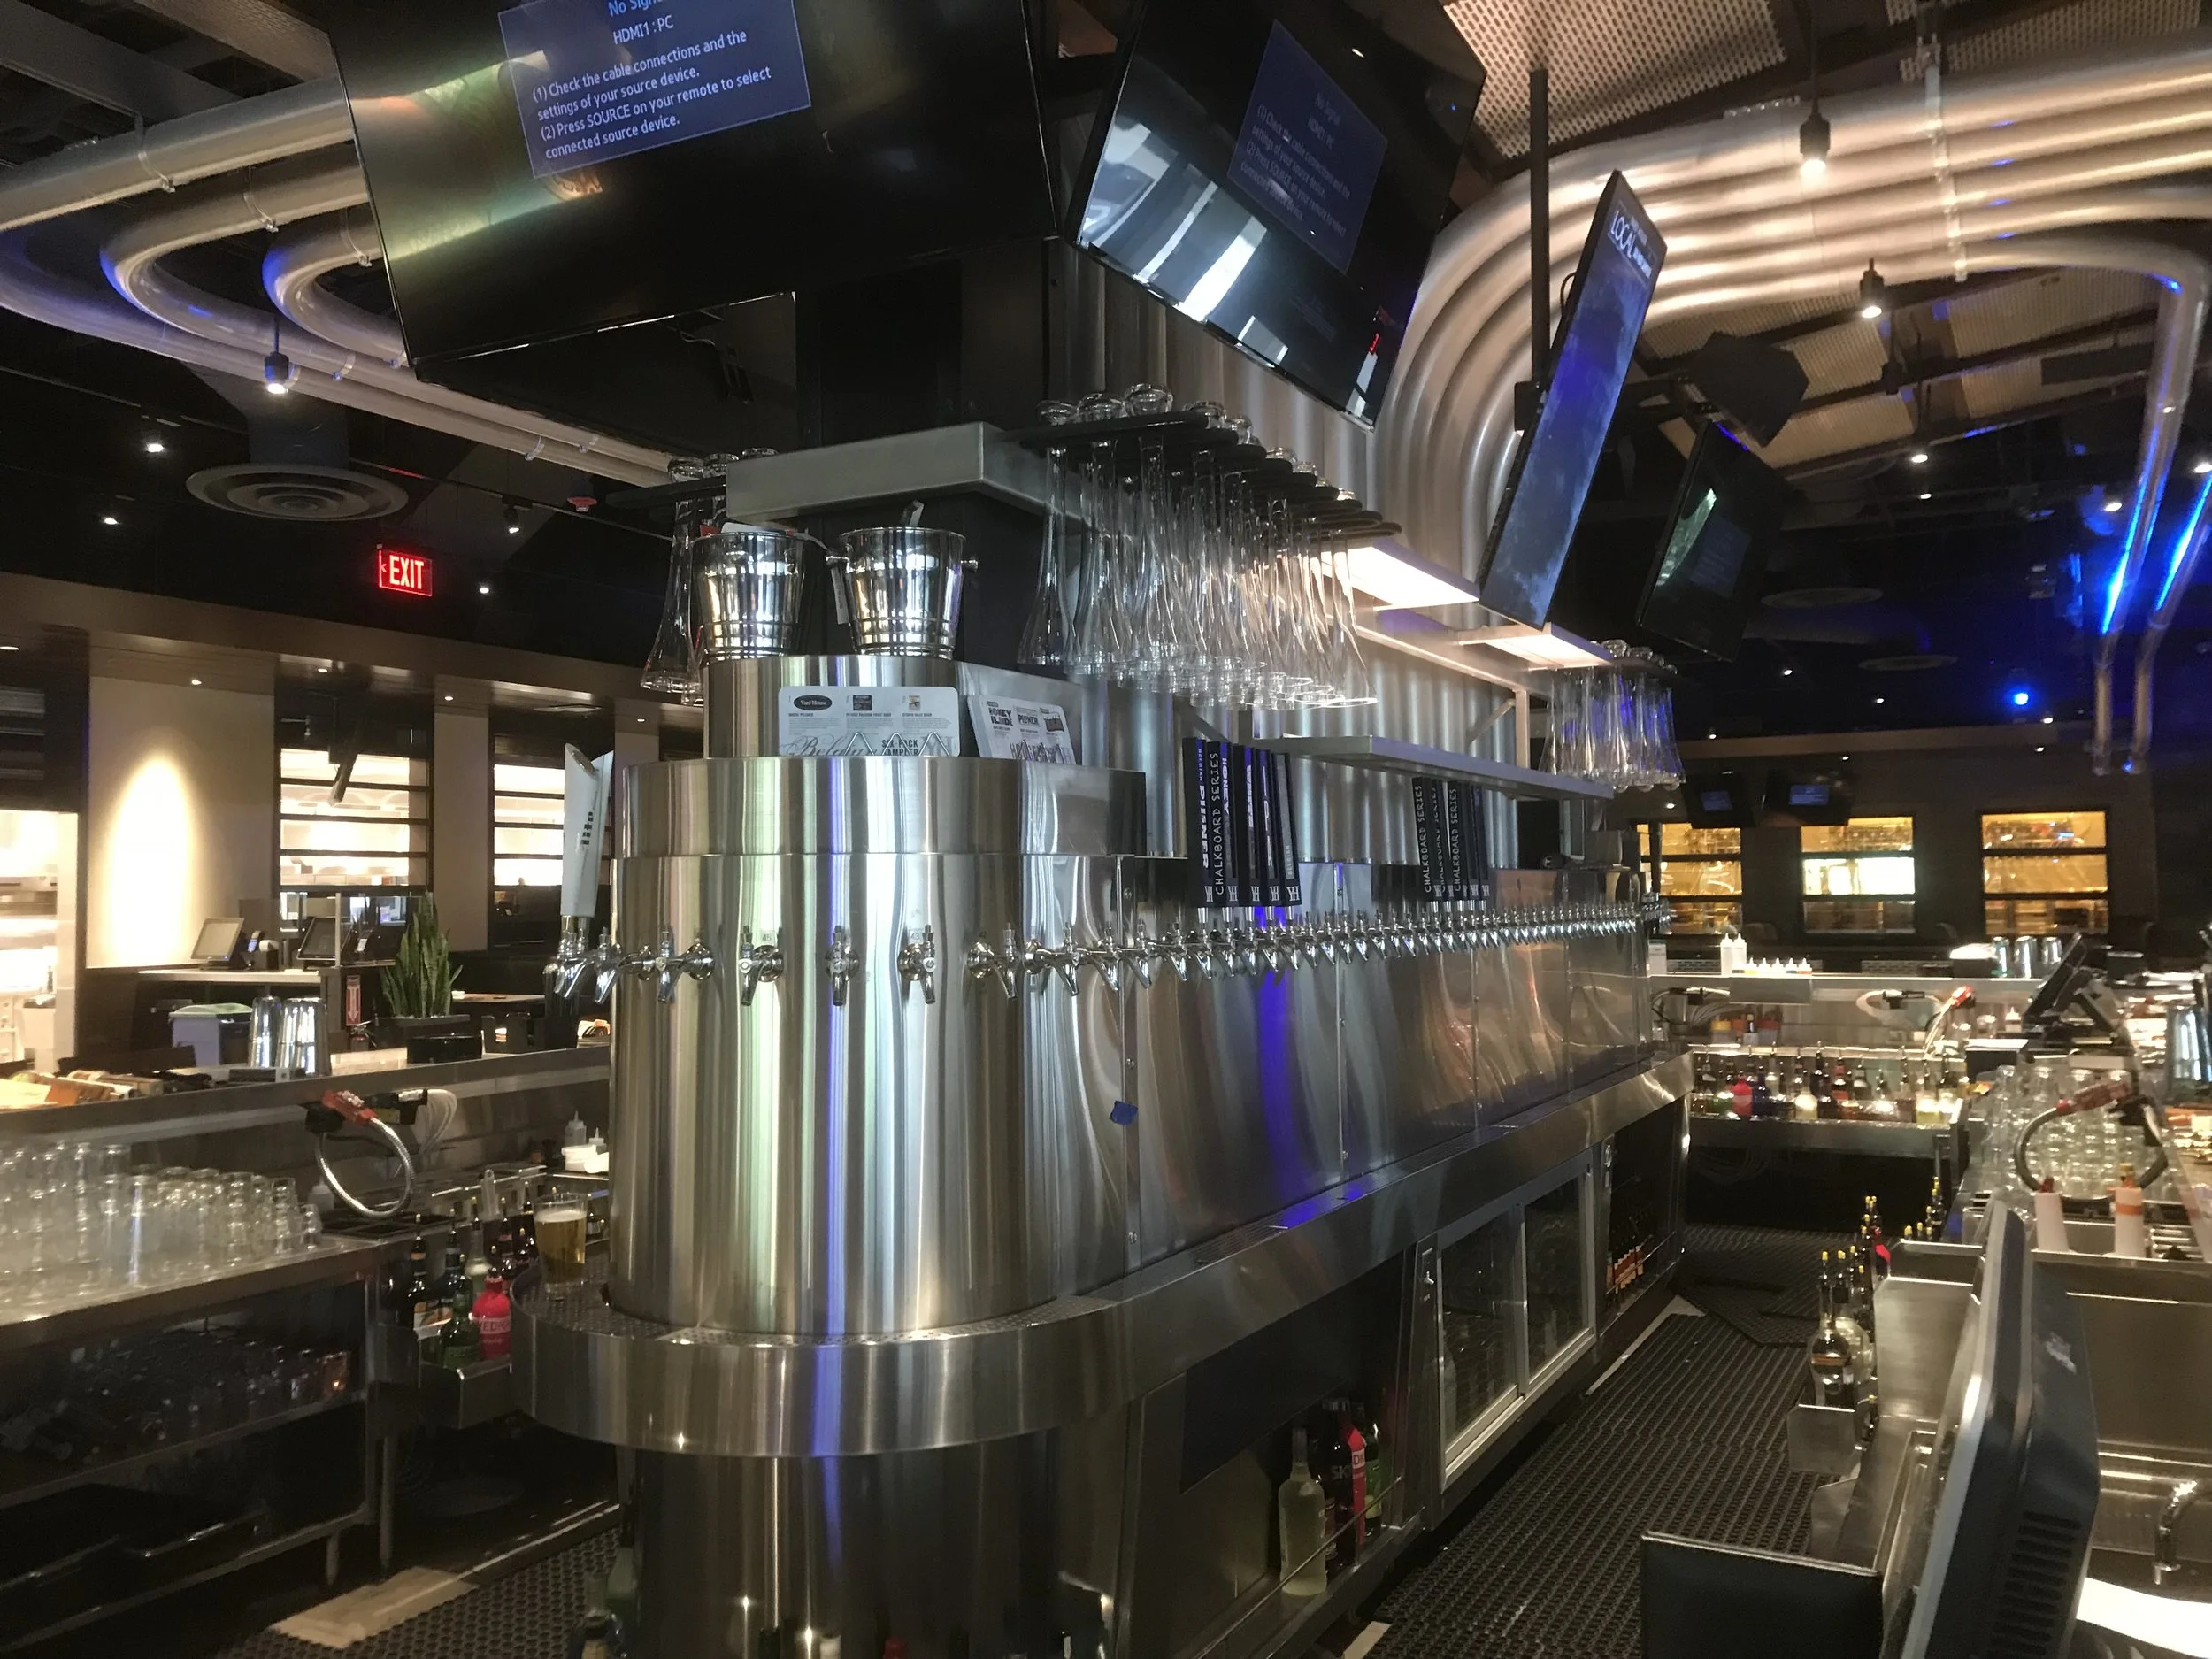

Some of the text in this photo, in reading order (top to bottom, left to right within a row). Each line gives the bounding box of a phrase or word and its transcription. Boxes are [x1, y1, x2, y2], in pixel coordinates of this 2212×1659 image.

[609, 1, 626, 16] No
[613, 21, 649, 44] HDMI1
[657, 14, 673, 32] PC
[533, 30, 747, 103] (1) Check the cable connections and the
[538, 67, 699, 120] settings of your source device.
[541, 66, 772, 142] (2) Press SOURCE on your remote to select
[546, 115, 680, 158] connected source device.
[389, 555, 424, 589] EXIT
[1210, 752, 1224, 895] CHALKBOARD SERIES
[1415, 785, 1432, 893] CHALKBOARD SERIES
[1449, 788, 1461, 892] CHALKBOARD SERIES
